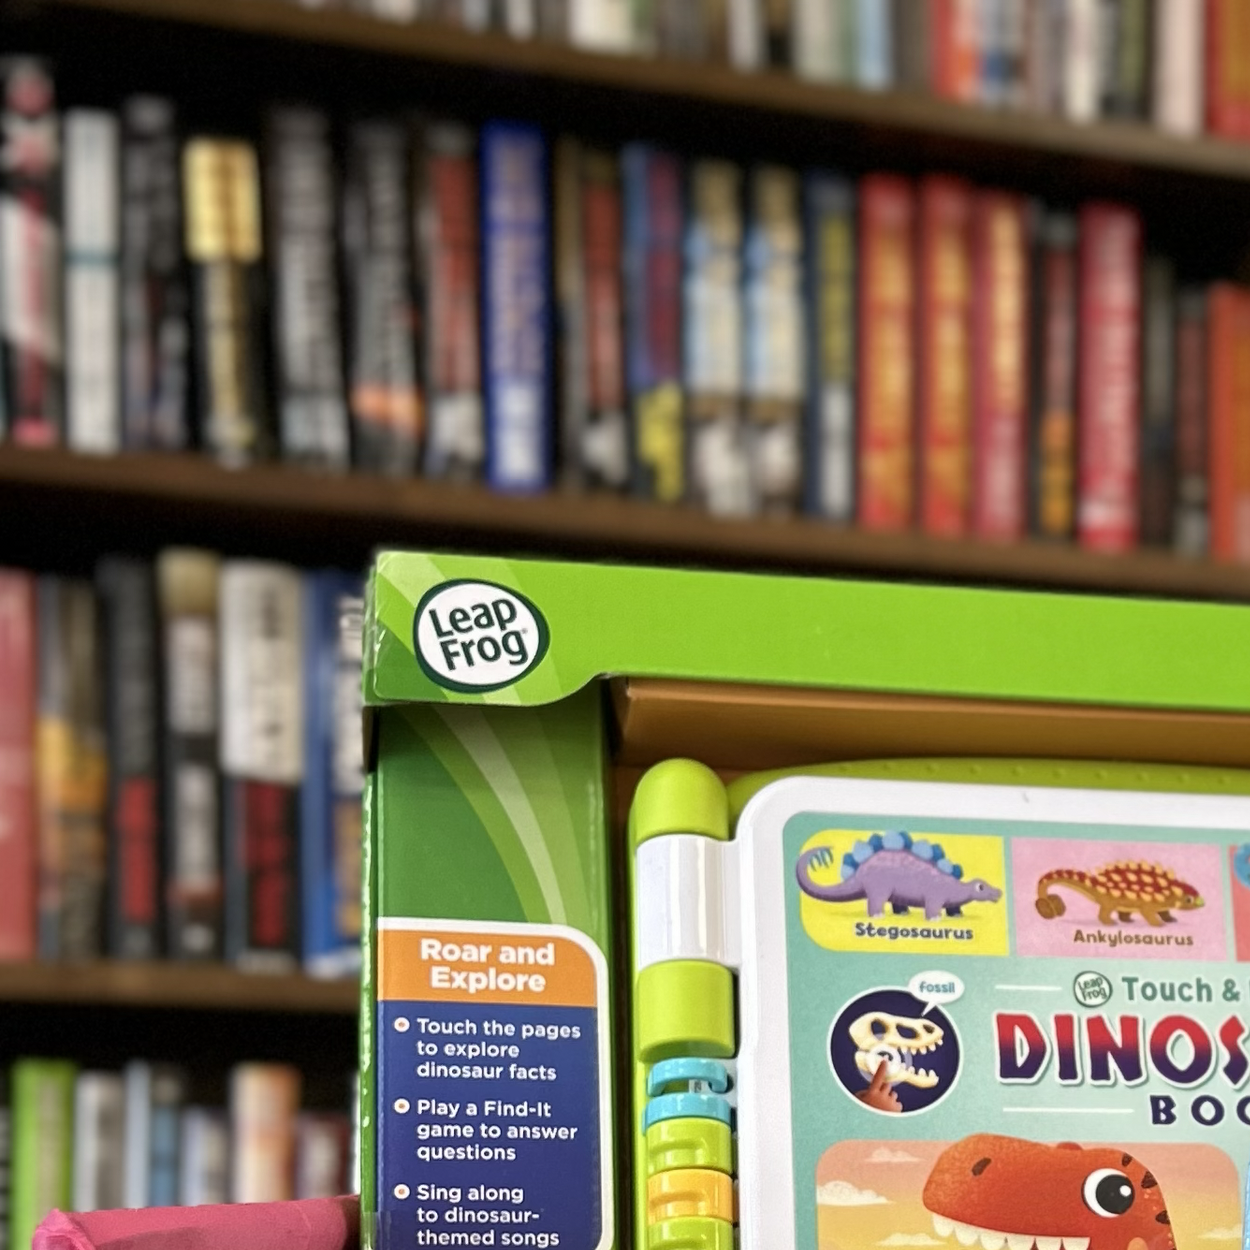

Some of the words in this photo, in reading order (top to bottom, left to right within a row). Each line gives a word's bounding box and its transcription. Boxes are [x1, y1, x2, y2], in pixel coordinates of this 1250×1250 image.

[428, 598, 517, 639] Leap
[439, 630, 529, 671] Frog
[855, 922, 974, 941] Stegosaurus
[1073, 929, 1194, 948] Ankylosaurus
[420, 938, 492, 963] Roar
[498, 942, 555, 966] and
[431, 966, 546, 993] Explore
[918, 981, 956, 995] fossil
[1122, 977, 1213, 1002] Touch
[1222, 979, 1241, 1002] &
[417, 1018, 477, 1035] Touch
[484, 1020, 516, 1036] the
[522, 1023, 581, 1040] pages
[416, 1040, 438, 1055] to
[444, 1041, 519, 1059] explore
[417, 1062, 503, 1079] dinosaur
[510, 1064, 557, 1081] facts
[417, 1099, 460, 1118] Play
[466, 1102, 477, 1116] a
[484, 1100, 551, 1117] Find-It
[417, 1124, 474, 1140] game
[480, 1123, 501, 1138] to
[507, 1126, 578, 1139] answer
[417, 1144, 516, 1161] questions
[417, 1184, 461, 1203] Sing
[467, 1185, 524, 1204] along
[417, 1207, 438, 1222] to
[445, 1207, 540, 1223] dinosaur-
[417, 1230, 495, 1246] themed
[501, 1233, 560, 1248] songs
